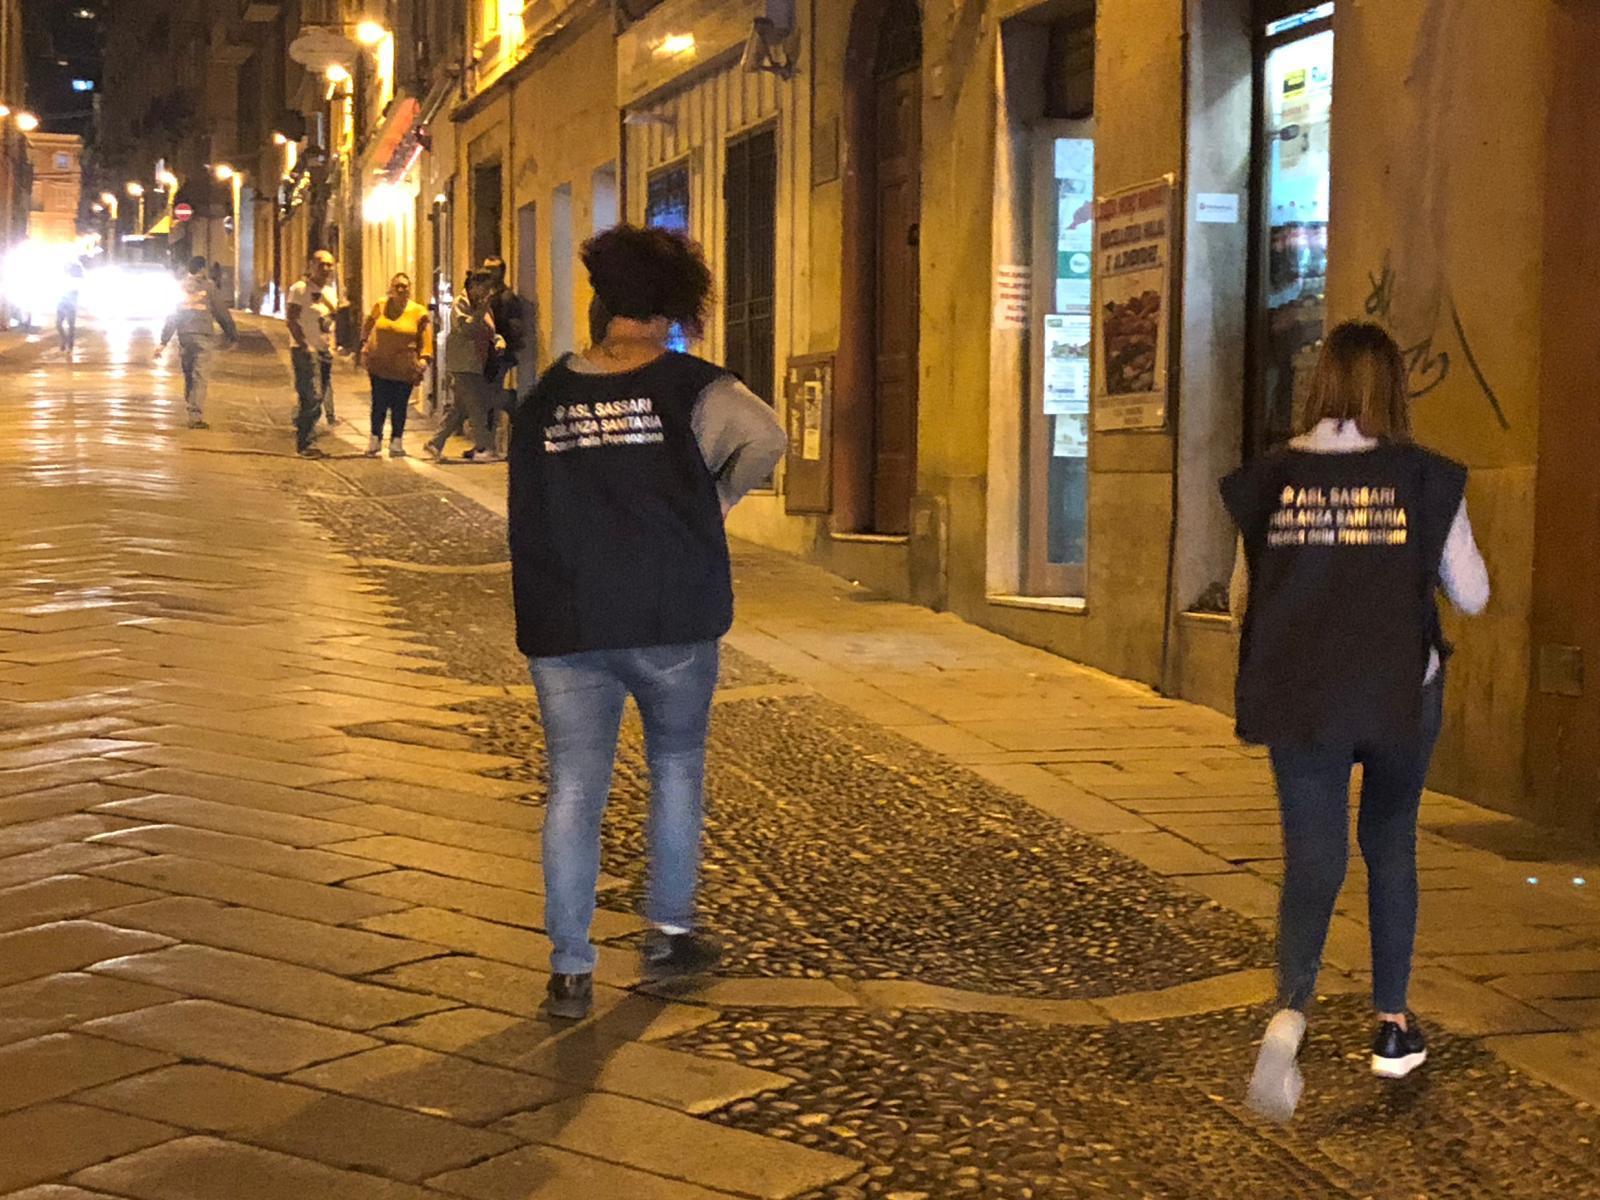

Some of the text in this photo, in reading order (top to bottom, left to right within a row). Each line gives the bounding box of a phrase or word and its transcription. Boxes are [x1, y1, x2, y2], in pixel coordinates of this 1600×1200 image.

[568, 398, 653, 418] ASL SASSARI
[601, 415, 664, 433] SANITARIA
